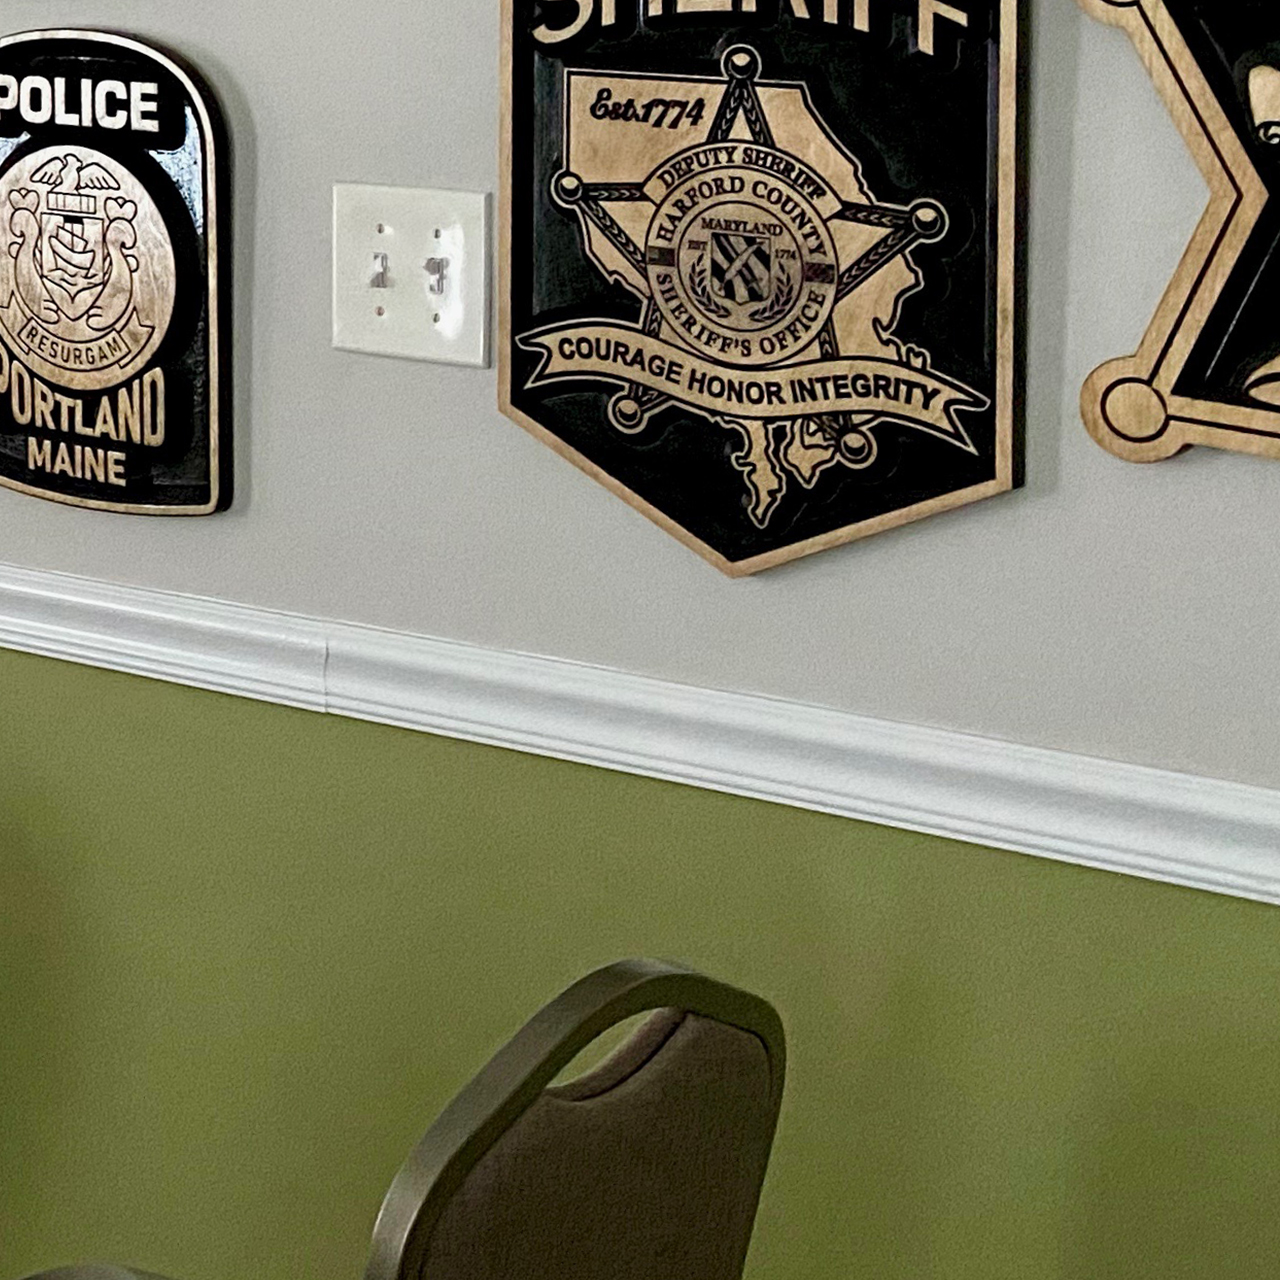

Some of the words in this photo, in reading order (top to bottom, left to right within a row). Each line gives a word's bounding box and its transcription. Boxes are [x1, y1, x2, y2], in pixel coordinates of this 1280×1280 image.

[657, 146, 738, 191] DEPUTY
[743, 147, 828, 201] SHERIFF
[656, 176, 745, 243] HARFORD
[752, 180, 828, 258] COUNTY
[702, 218, 784, 237] MARYLAND
[775, 248, 797, 261] 1774
[656, 273, 752, 357] SHERIFF'S
[759, 290, 826, 355] OFFICE
[25, 324, 124, 367] RESURGAM
[557, 335, 685, 385] COURAGE
[686, 367, 786, 406] HONOR
[789, 372, 944, 411] INTEGRITY
[27, 436, 126, 487] MAINE
